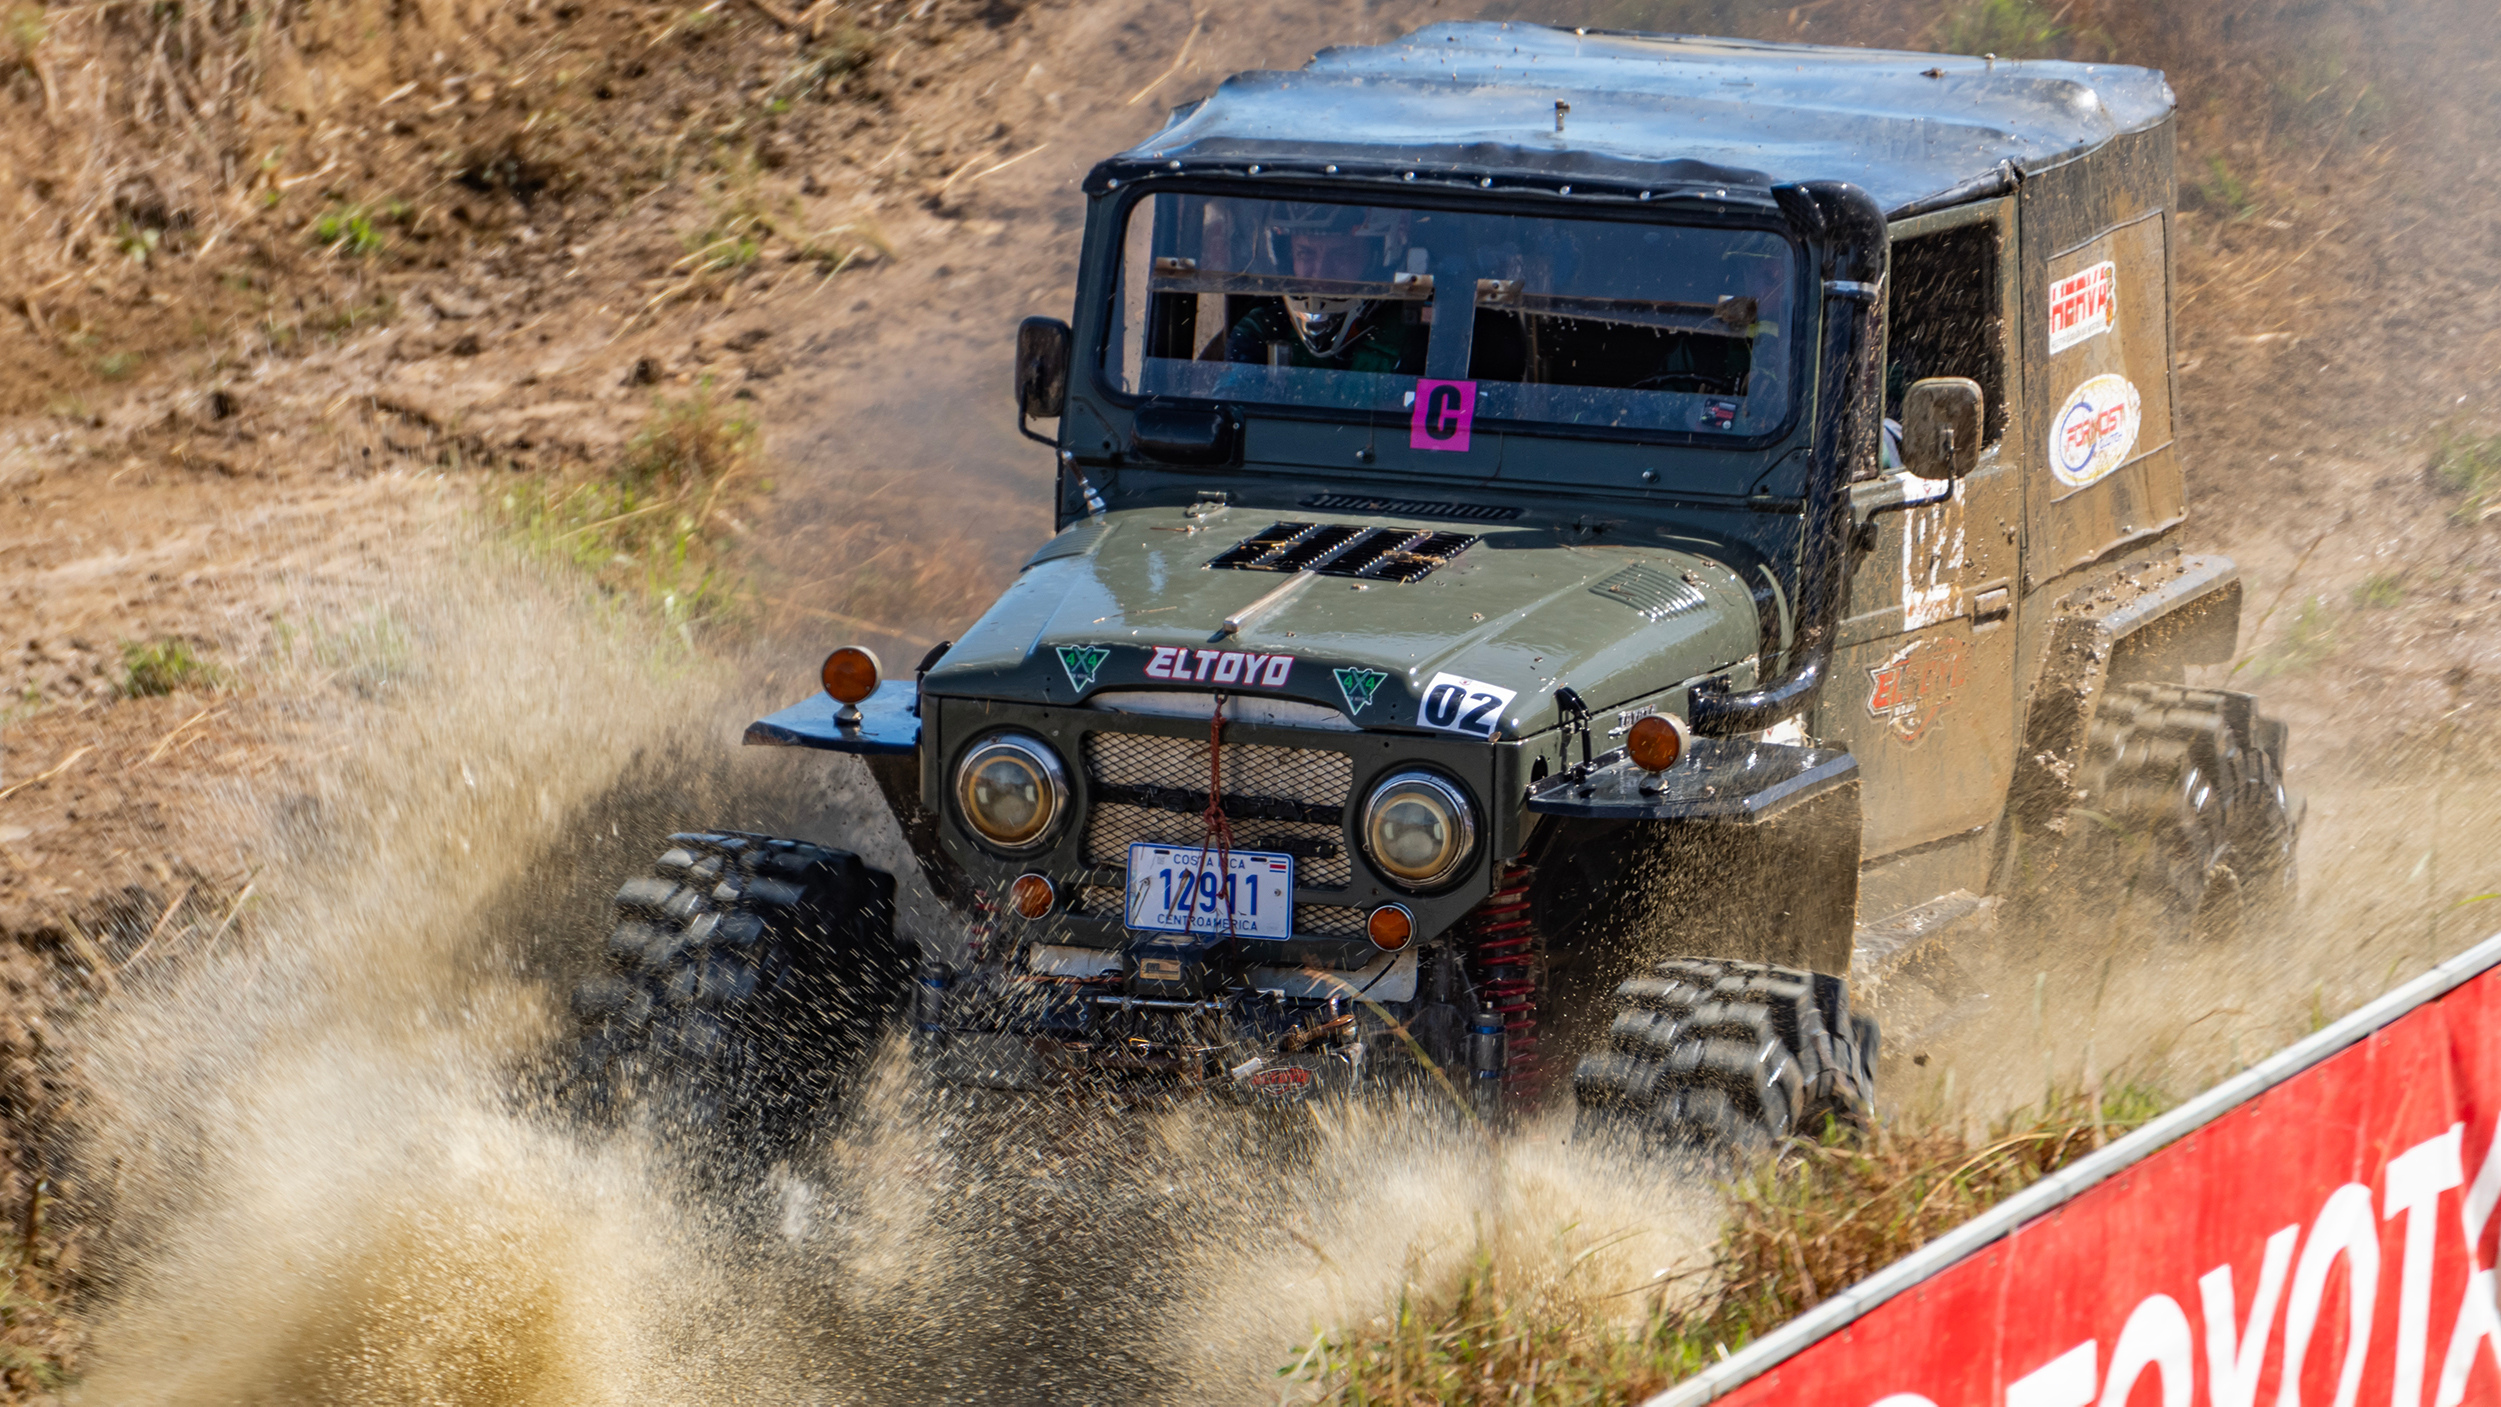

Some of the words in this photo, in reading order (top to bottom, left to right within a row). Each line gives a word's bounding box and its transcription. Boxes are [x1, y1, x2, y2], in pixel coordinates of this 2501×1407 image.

[1425, 384, 1462, 441] C
[1065, 647, 1098, 673] 4X4
[1343, 670, 1376, 696] 4X4
[1424, 683, 1503, 735] 02
[1173, 853, 1214, 868] COSA
[1218, 857, 1246, 869] CA
[1159, 868, 1258, 916] 12911
[2002, 1108, 2501, 1407] YOT
